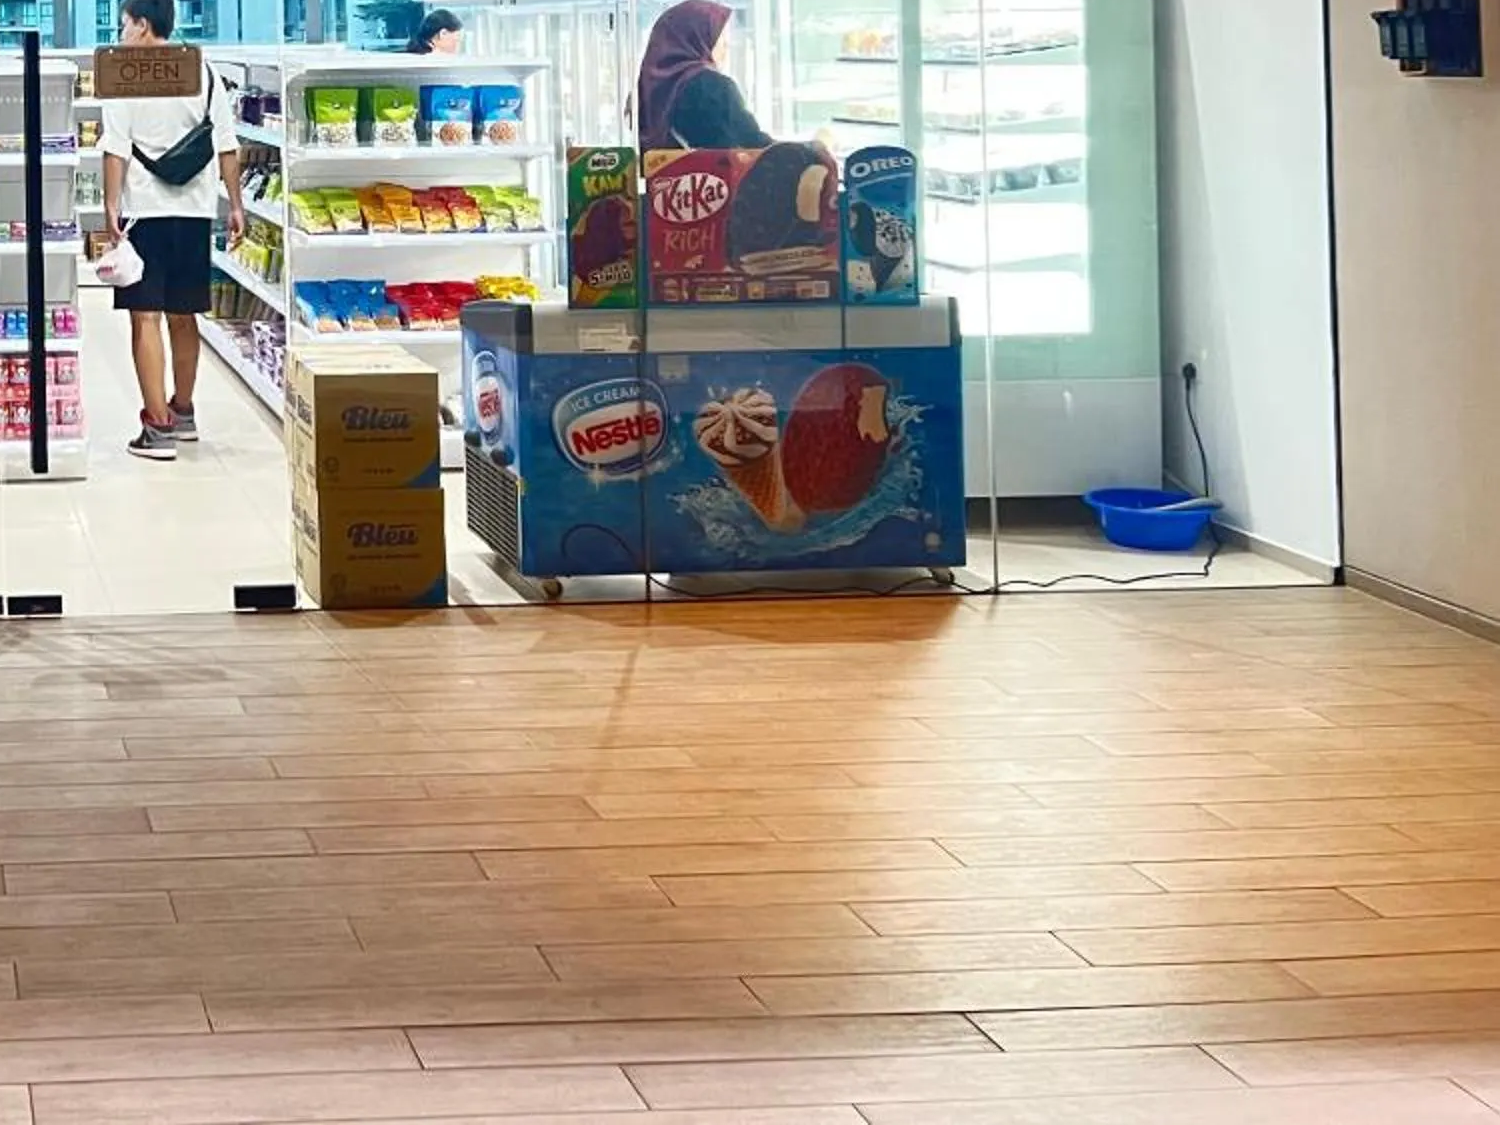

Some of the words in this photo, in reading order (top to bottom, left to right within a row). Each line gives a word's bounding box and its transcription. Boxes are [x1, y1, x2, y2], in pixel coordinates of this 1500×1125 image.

[119, 61, 179, 82] OPEN
[850, 156, 914, 179] OREO
[661, 174, 725, 222] KitKat
[341, 405, 412, 431] Bleu
[347, 522, 419, 548] Bleu
